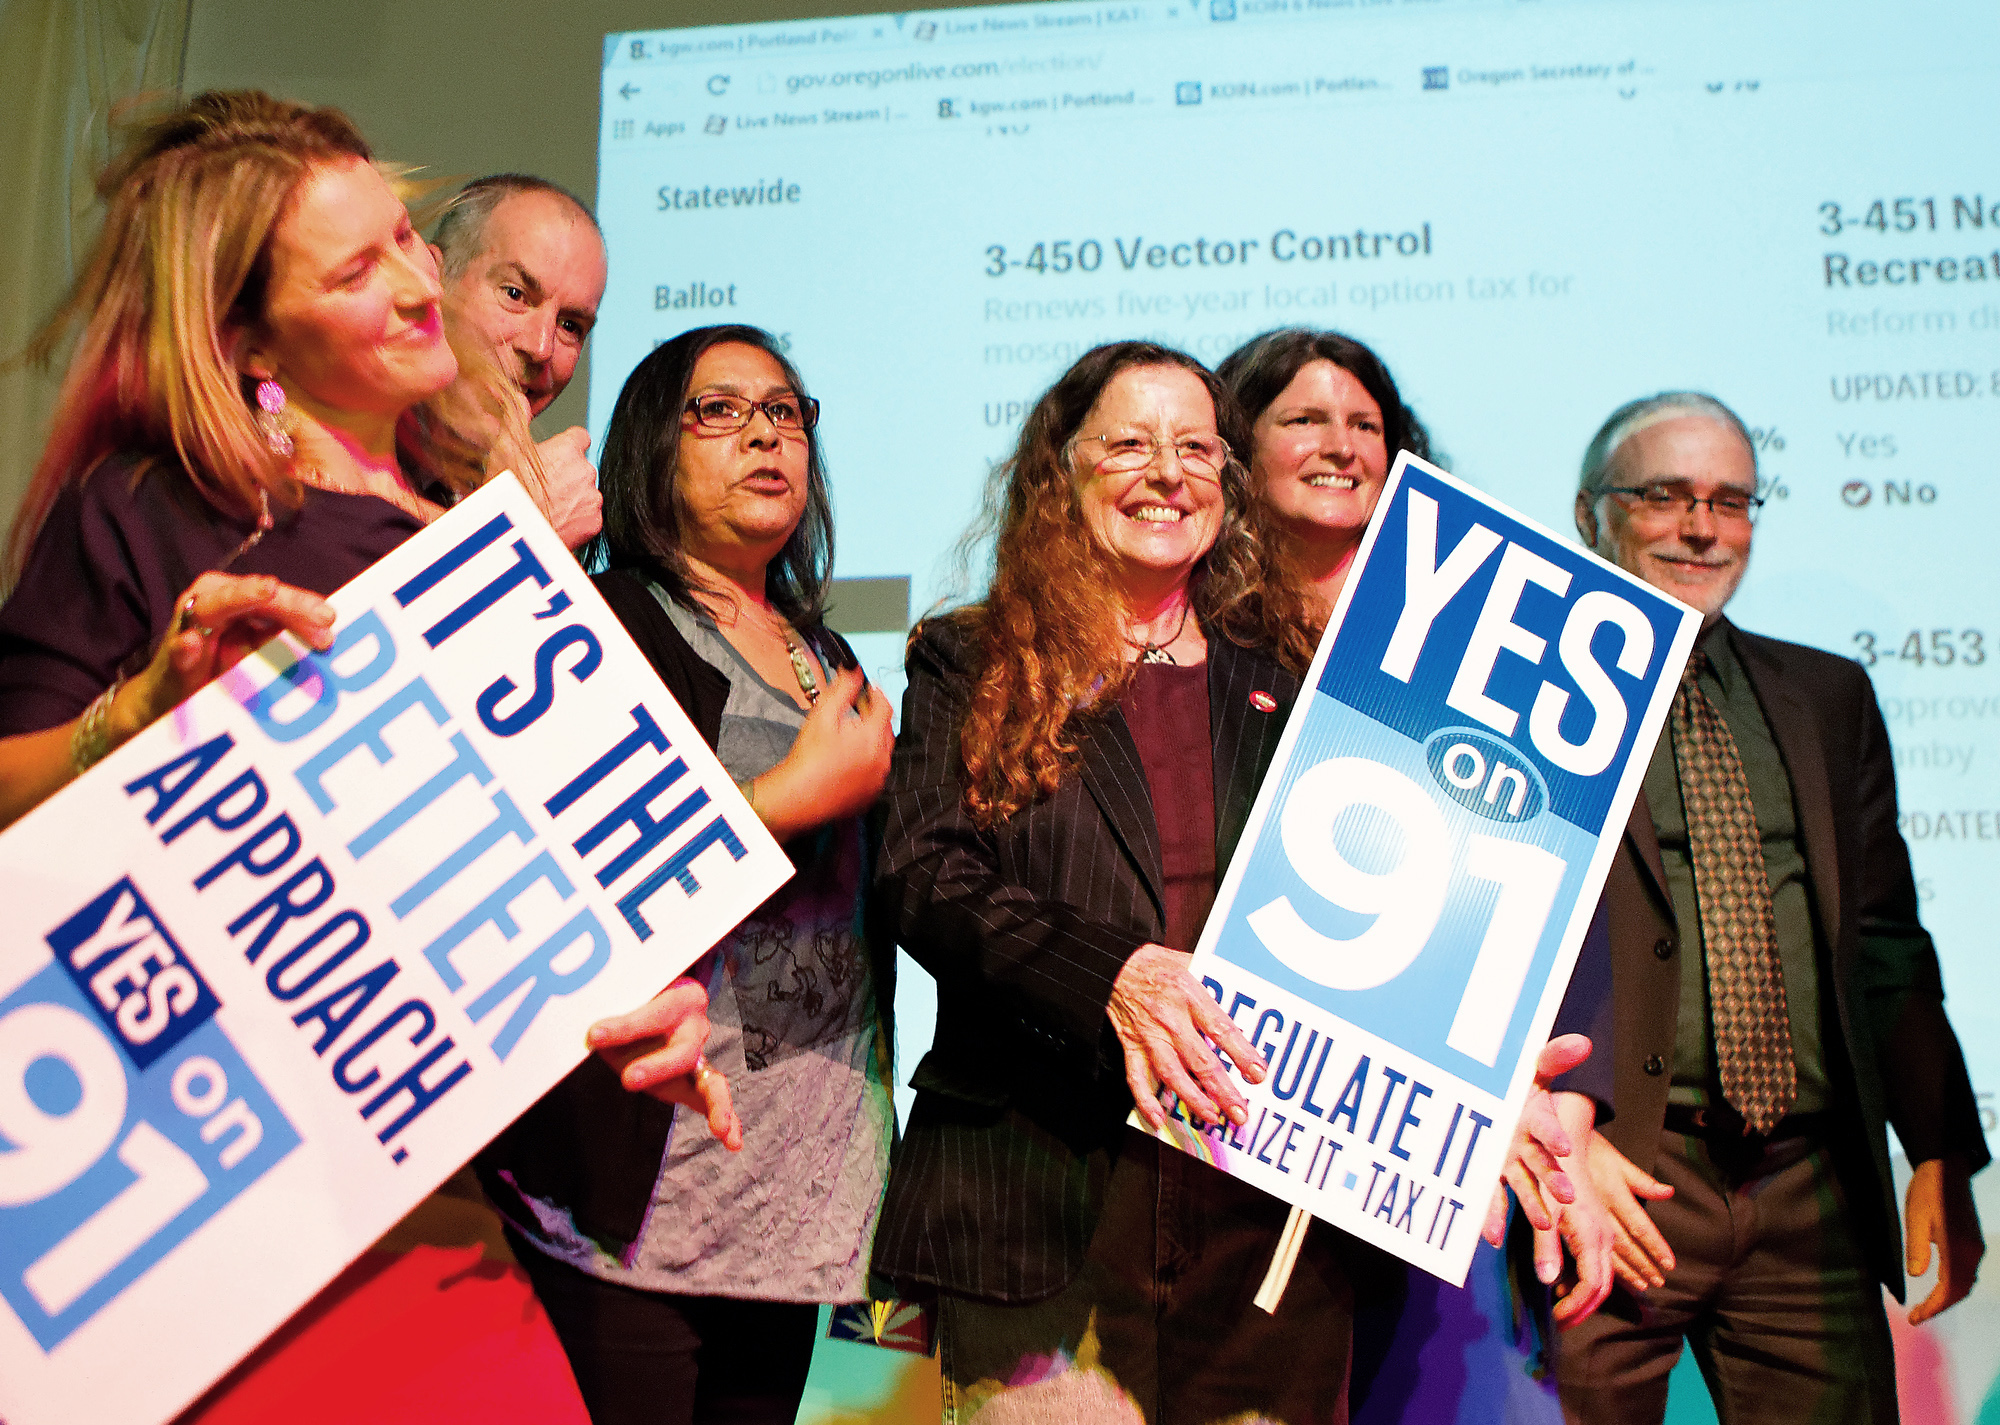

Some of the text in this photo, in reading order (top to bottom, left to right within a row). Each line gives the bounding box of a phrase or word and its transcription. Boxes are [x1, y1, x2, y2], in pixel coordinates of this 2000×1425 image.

[644, 120, 686, 136] Apps
[657, 178, 802, 211] Statewide
[1817, 197, 1937, 236] 3-451
[984, 221, 1432, 278] 3-450 Vector Control
[654, 281, 737, 311] Ballot
[983, 270, 1575, 324] Renews five-year local option tax for
[1825, 309, 1957, 336] Reform
[1830, 369, 1984, 402] UPDATED:
[1836, 431, 1899, 458] Yes
[1884, 480, 1938, 506] No
[1379, 487, 1656, 780] YES
[1853, 629, 1987, 668] 3-453
[391, 511, 748, 944] IT'S THE
[1440, 743, 1528, 815] on
[238, 608, 614, 1065] BETTER
[1246, 755, 1568, 1070] 91
[70, 888, 199, 1045] YES
[123, 730, 474, 1166] APPROACH.
[170, 1056, 264, 1173] on
[1433, 1103, 1493, 1188] IT
[0, 1001, 210, 1318] 91
[1304, 1135, 1343, 1190] IT
[1362, 1161, 1425, 1234] TAX
[1426, 1195, 1464, 1251] IT
